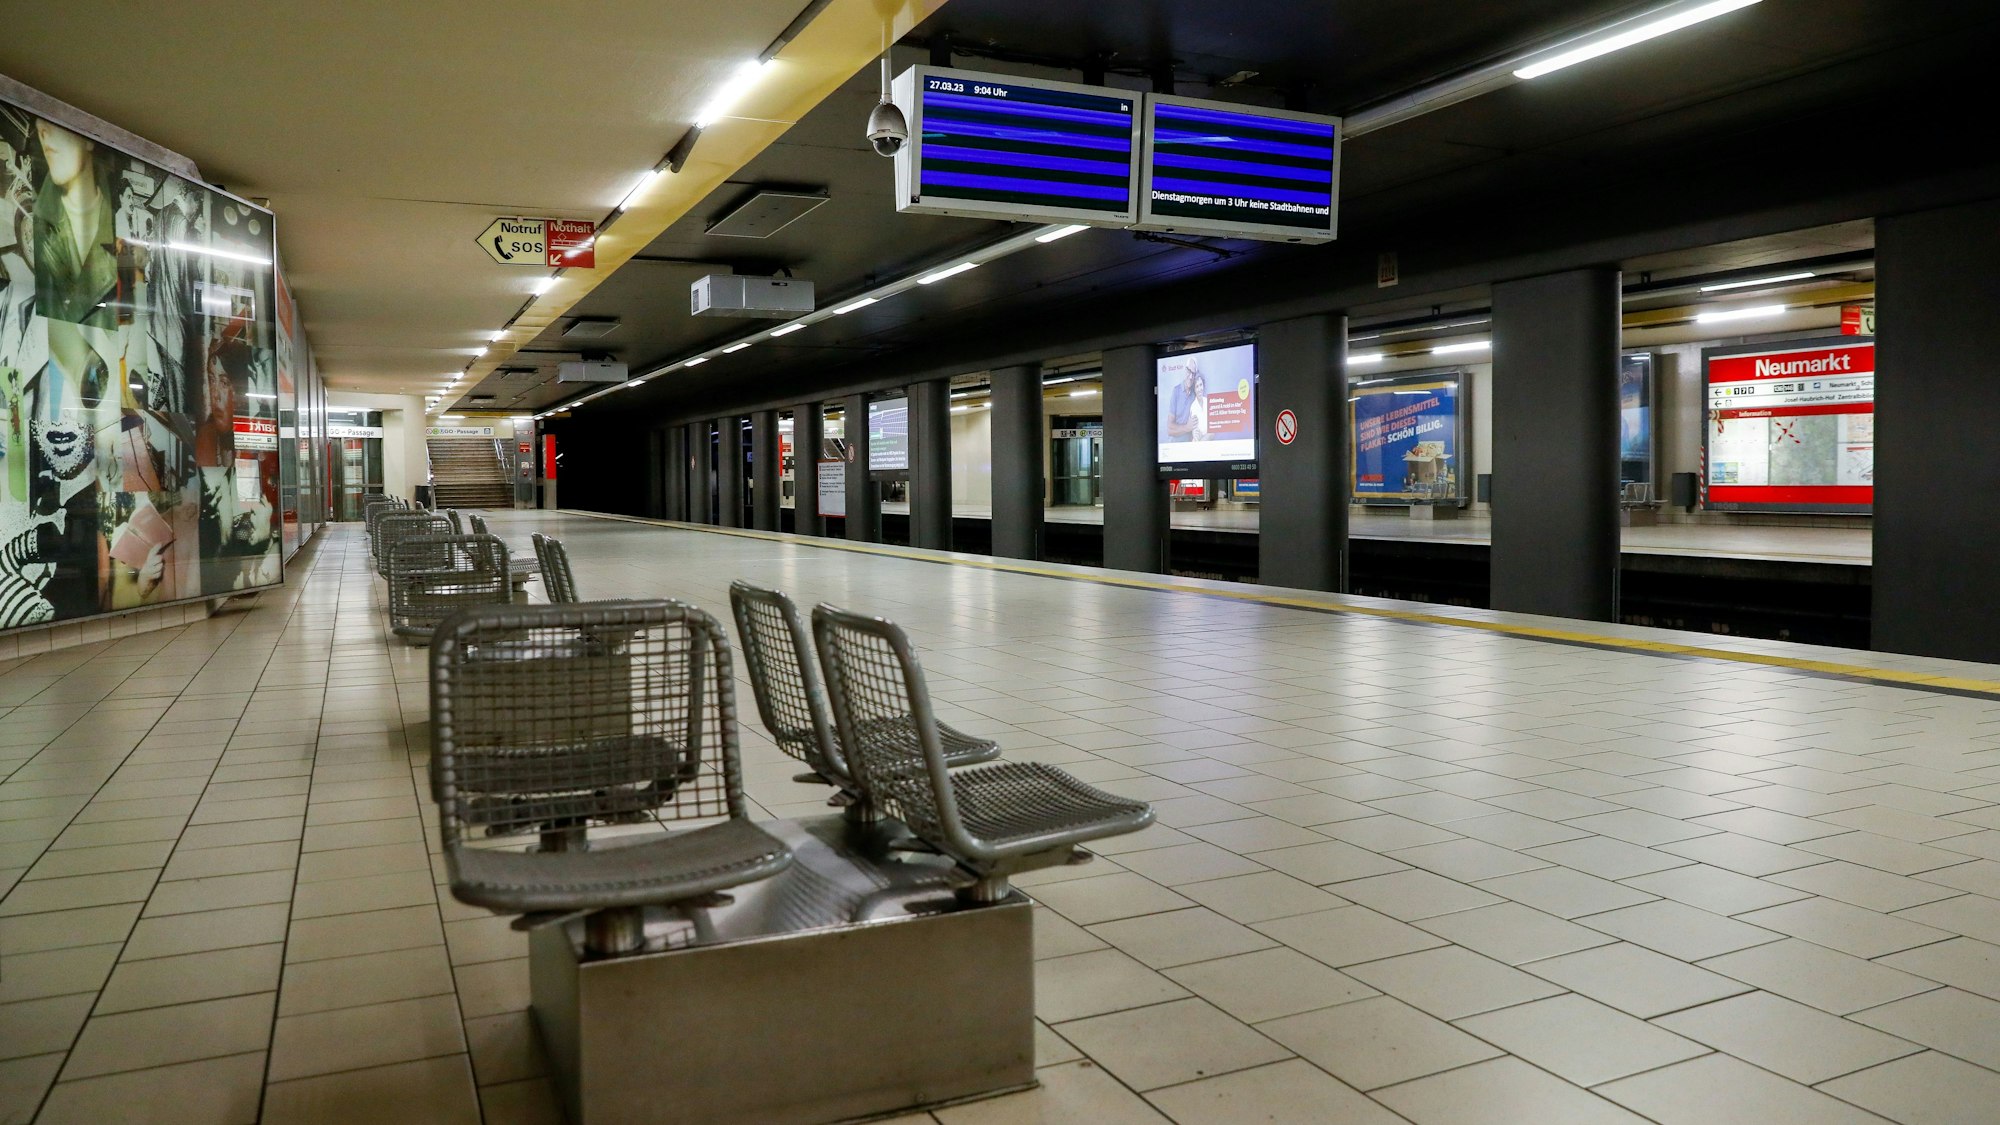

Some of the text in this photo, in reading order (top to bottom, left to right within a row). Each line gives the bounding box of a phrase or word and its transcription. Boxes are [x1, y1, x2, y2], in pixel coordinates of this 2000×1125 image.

[929, 80, 1008, 97] 27.03.23 9:04 Uhr
[1120, 103, 1128, 112] in
[1152, 190, 1329, 216] Dienstagmorgen um 3 Uhr keine Stadtbahnen und
[501, 222, 542, 235] Notruf
[550, 222, 591, 234] Nothalt
[511, 241, 543, 253] SOS
[1755, 353, 1850, 377] Neumarkt
[1360, 397, 1440, 430] UNSERE LEBENSMITTEL
[347, 428, 375, 437] Passage
[1360, 416, 1417, 441] SIND WIE DIESES
[1360, 419, 1443, 452] PLAKAT: SCHÖN BILLIG.
